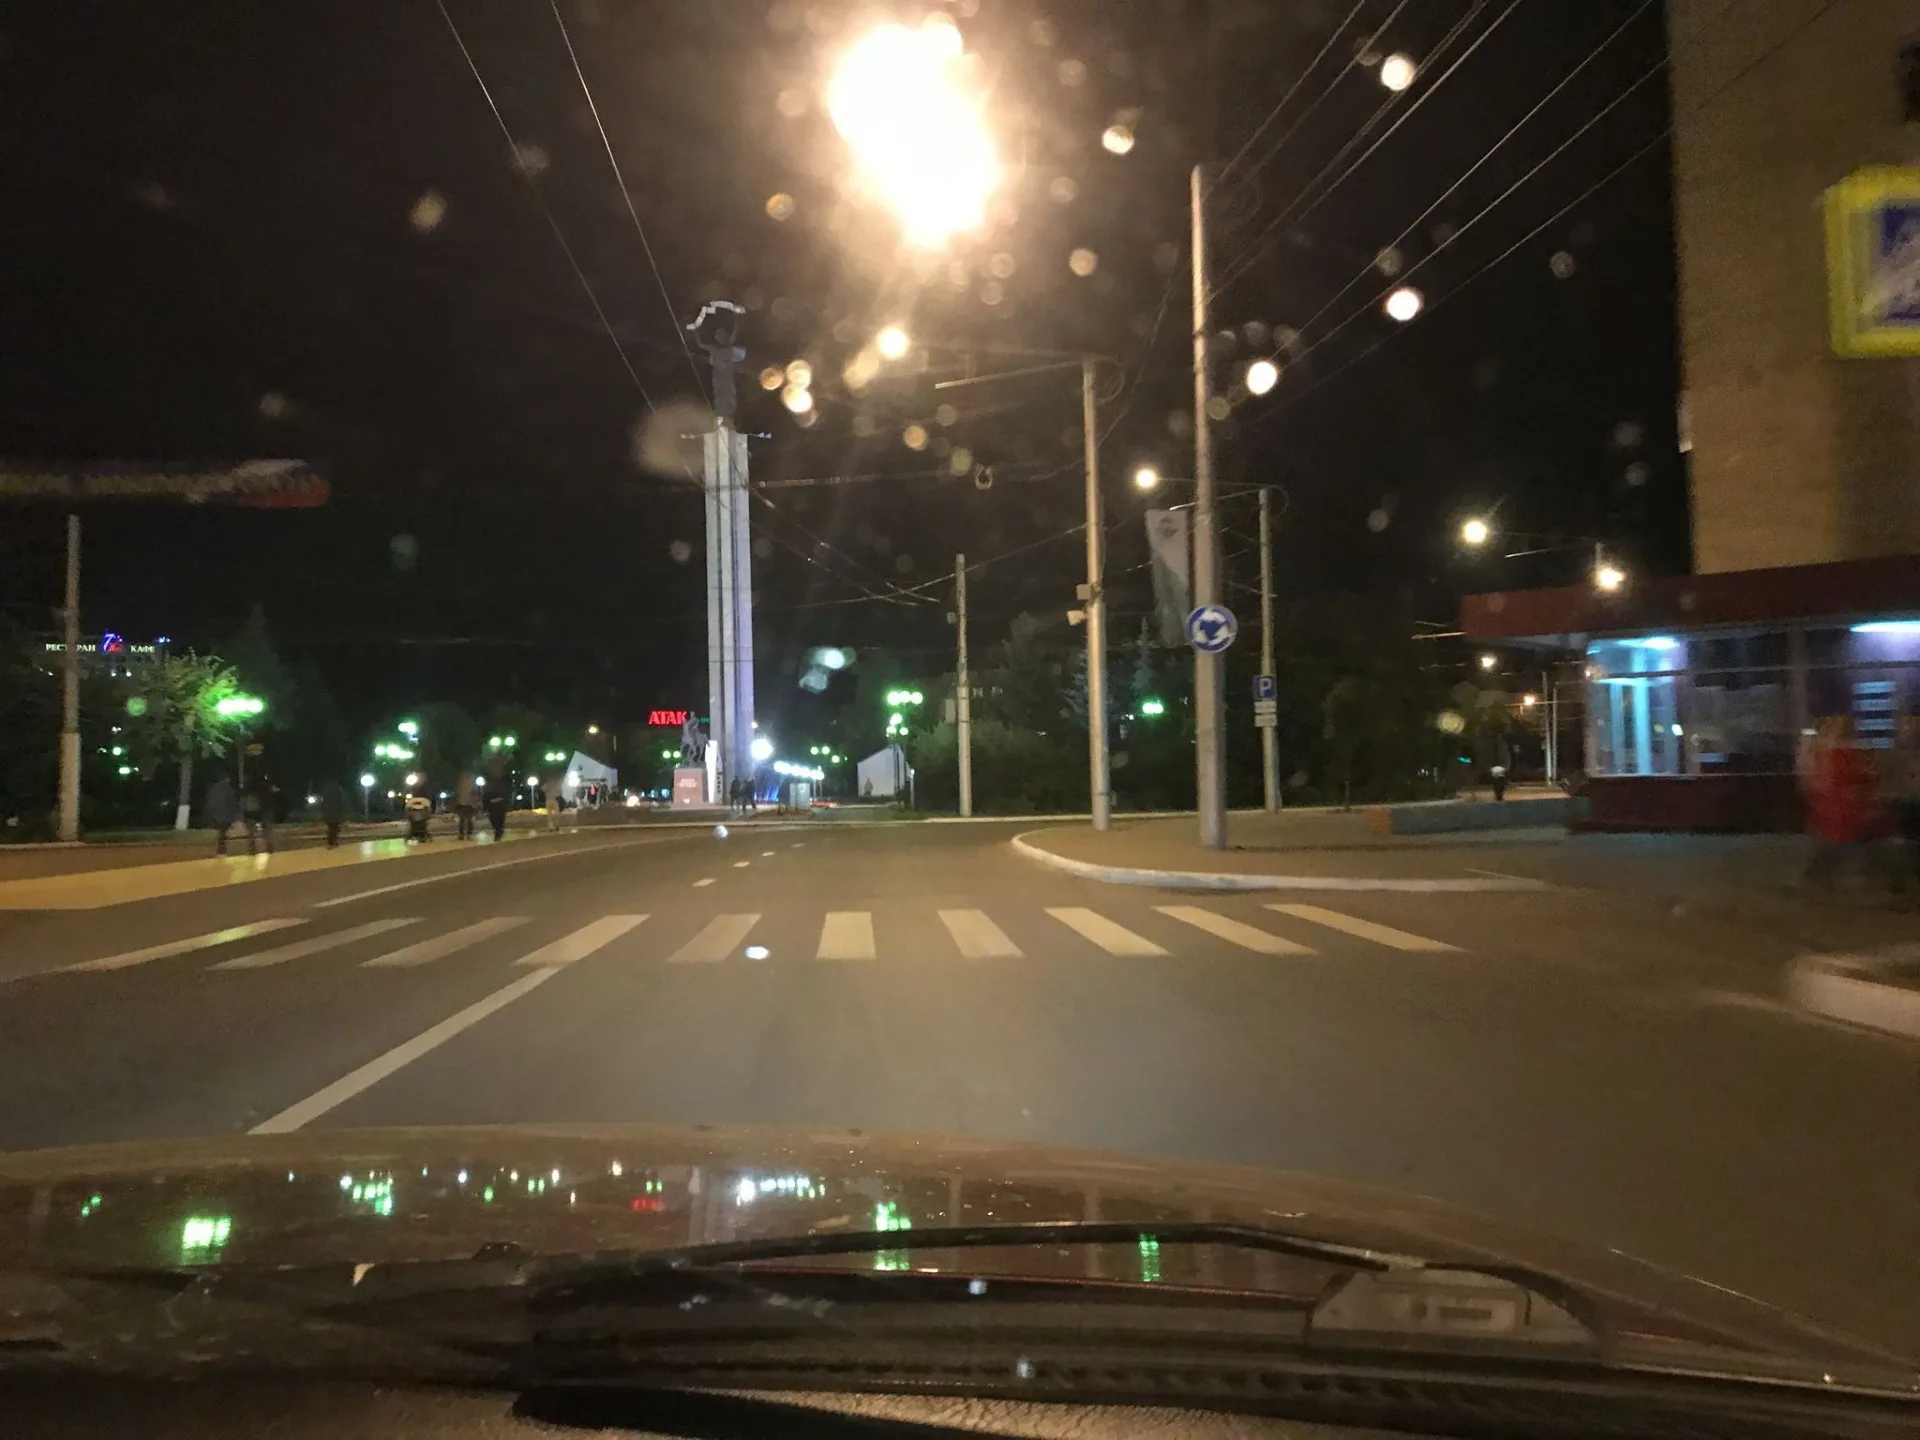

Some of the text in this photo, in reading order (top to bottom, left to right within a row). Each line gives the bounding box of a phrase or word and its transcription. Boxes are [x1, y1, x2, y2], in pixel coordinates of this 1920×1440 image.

[130, 645, 156, 653] КАФЕ
[1259, 677, 1272, 697] P
[648, 709, 688, 725] АТАК
